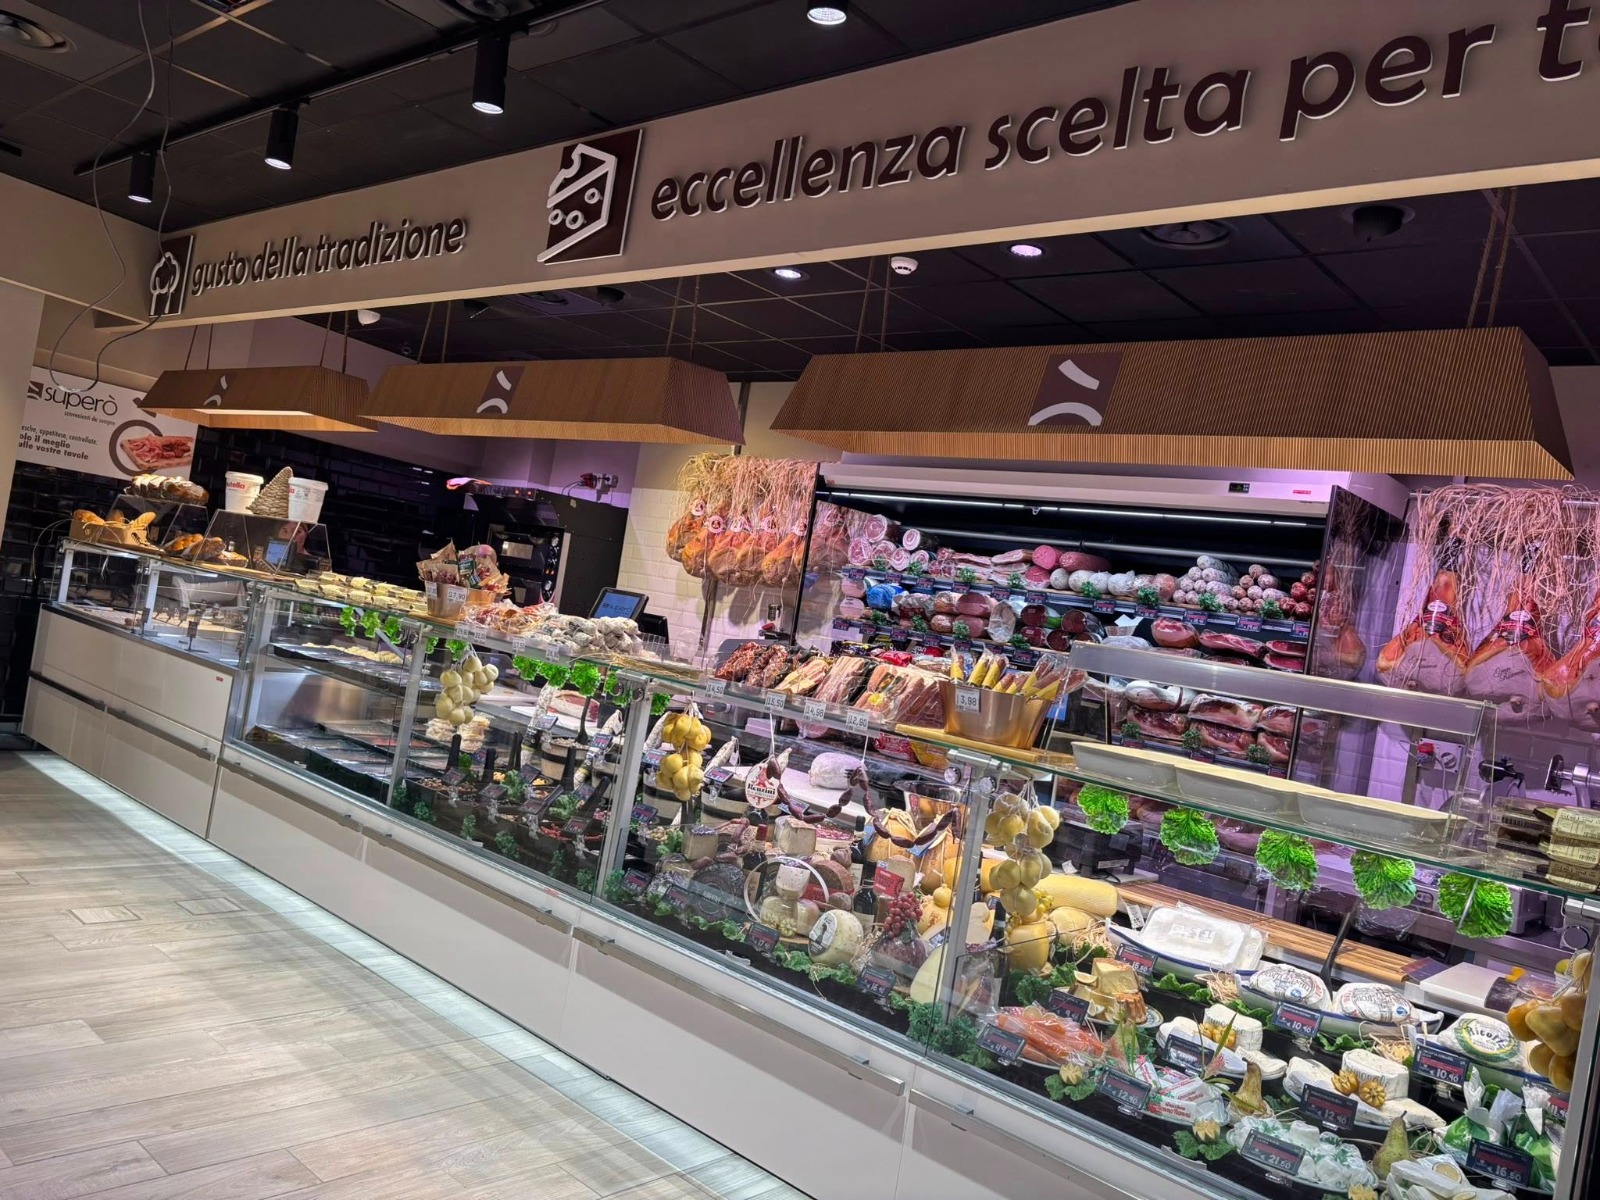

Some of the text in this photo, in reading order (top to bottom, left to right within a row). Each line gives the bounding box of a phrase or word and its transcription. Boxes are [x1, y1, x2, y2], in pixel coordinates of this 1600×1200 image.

[650, 0, 1600, 221] eccellenza scelta per t
[191, 218, 467, 297] gusto della tradizione
[44, 386, 118, 416] superò
[34, 434, 41, 443] il
[42, 437, 71, 449] meglio
[36, 445, 62, 455] vostre
[63, 449, 89, 460] tavole
